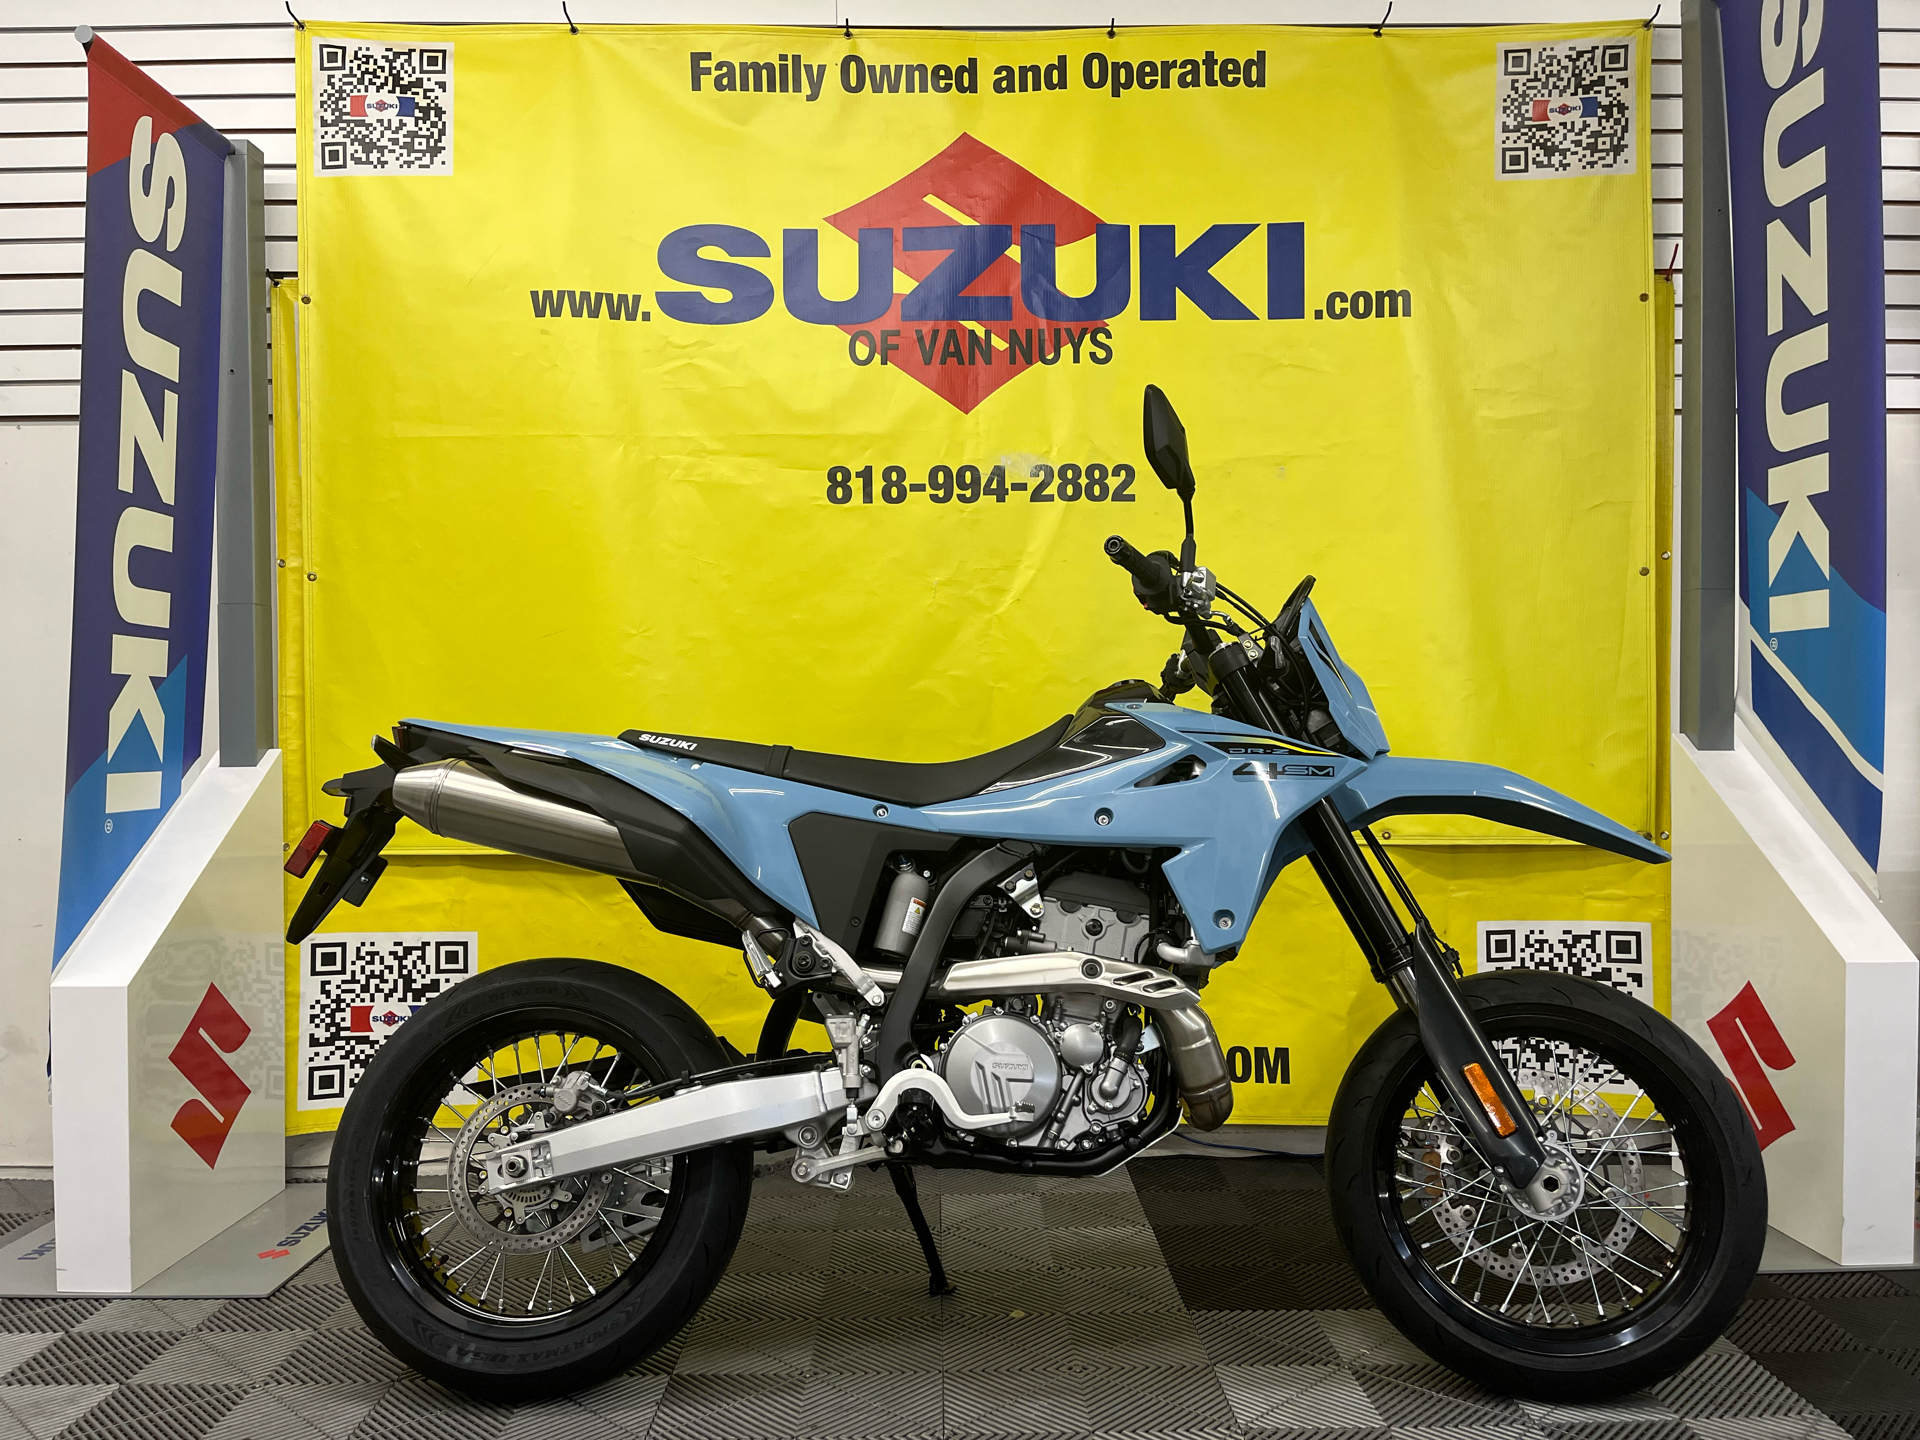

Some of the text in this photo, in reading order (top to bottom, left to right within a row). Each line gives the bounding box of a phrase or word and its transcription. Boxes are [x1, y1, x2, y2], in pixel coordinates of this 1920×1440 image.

[690, 50, 1267, 102] Family Owned and Operated
[1760, 0, 1830, 634] SUZUKI
[848, 326, 1113, 367] OF VAN NUYS
[105, 115, 187, 814] SUZUKI
[826, 463, 1136, 505] 818-994-2882
[638, 733, 698, 751] SUZUKI
[1228, 747, 1290, 755] DR-Z
[372, 1015, 411, 1023] SUZUK
[991, 1062, 1029, 1071] SUZUKI
[1225, 1045, 1291, 1085] OM
[276, 1210, 327, 1247] SUZU
